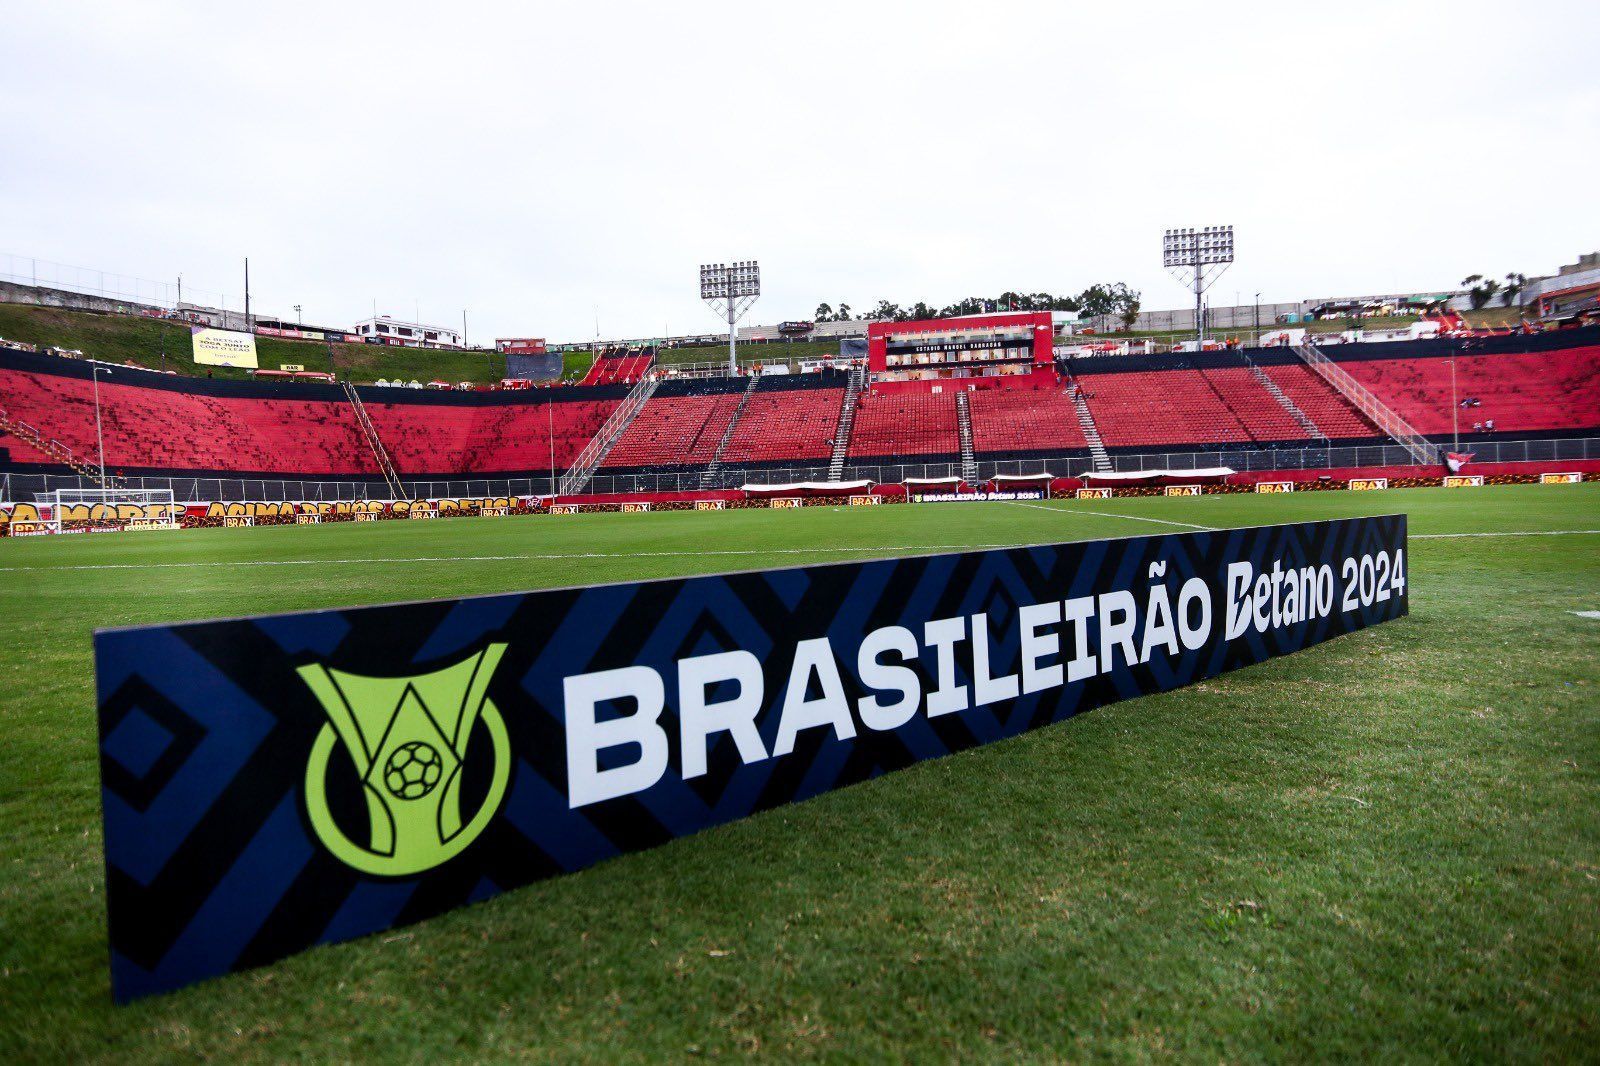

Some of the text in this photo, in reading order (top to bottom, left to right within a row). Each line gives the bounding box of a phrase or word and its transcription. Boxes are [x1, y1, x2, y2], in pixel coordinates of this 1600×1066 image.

[1545, 474, 1579, 483] BRAX
[1353, 480, 1385, 490] BRAX
[1448, 479, 1480, 487] BRAX
[1169, 487, 1198, 496] BRAX
[1259, 484, 1290, 493] BRAX
[1080, 490, 1108, 498] BRAX
[773, 500, 799, 508] BRAX
[852, 497, 878, 505] BRAX
[552, 506, 575, 514] BRAX
[624, 504, 648, 512] BRAX
[698, 502, 722, 510] BRAX
[357, 513, 375, 521] BRAX
[412, 511, 435, 519] BRAX
[483, 509, 506, 517] BRAX
[227, 517, 252, 527] BRAX
[299, 515, 320, 524] BRAX
[564, 548, 1405, 808] BRASILEIRÃO Betano 2024
